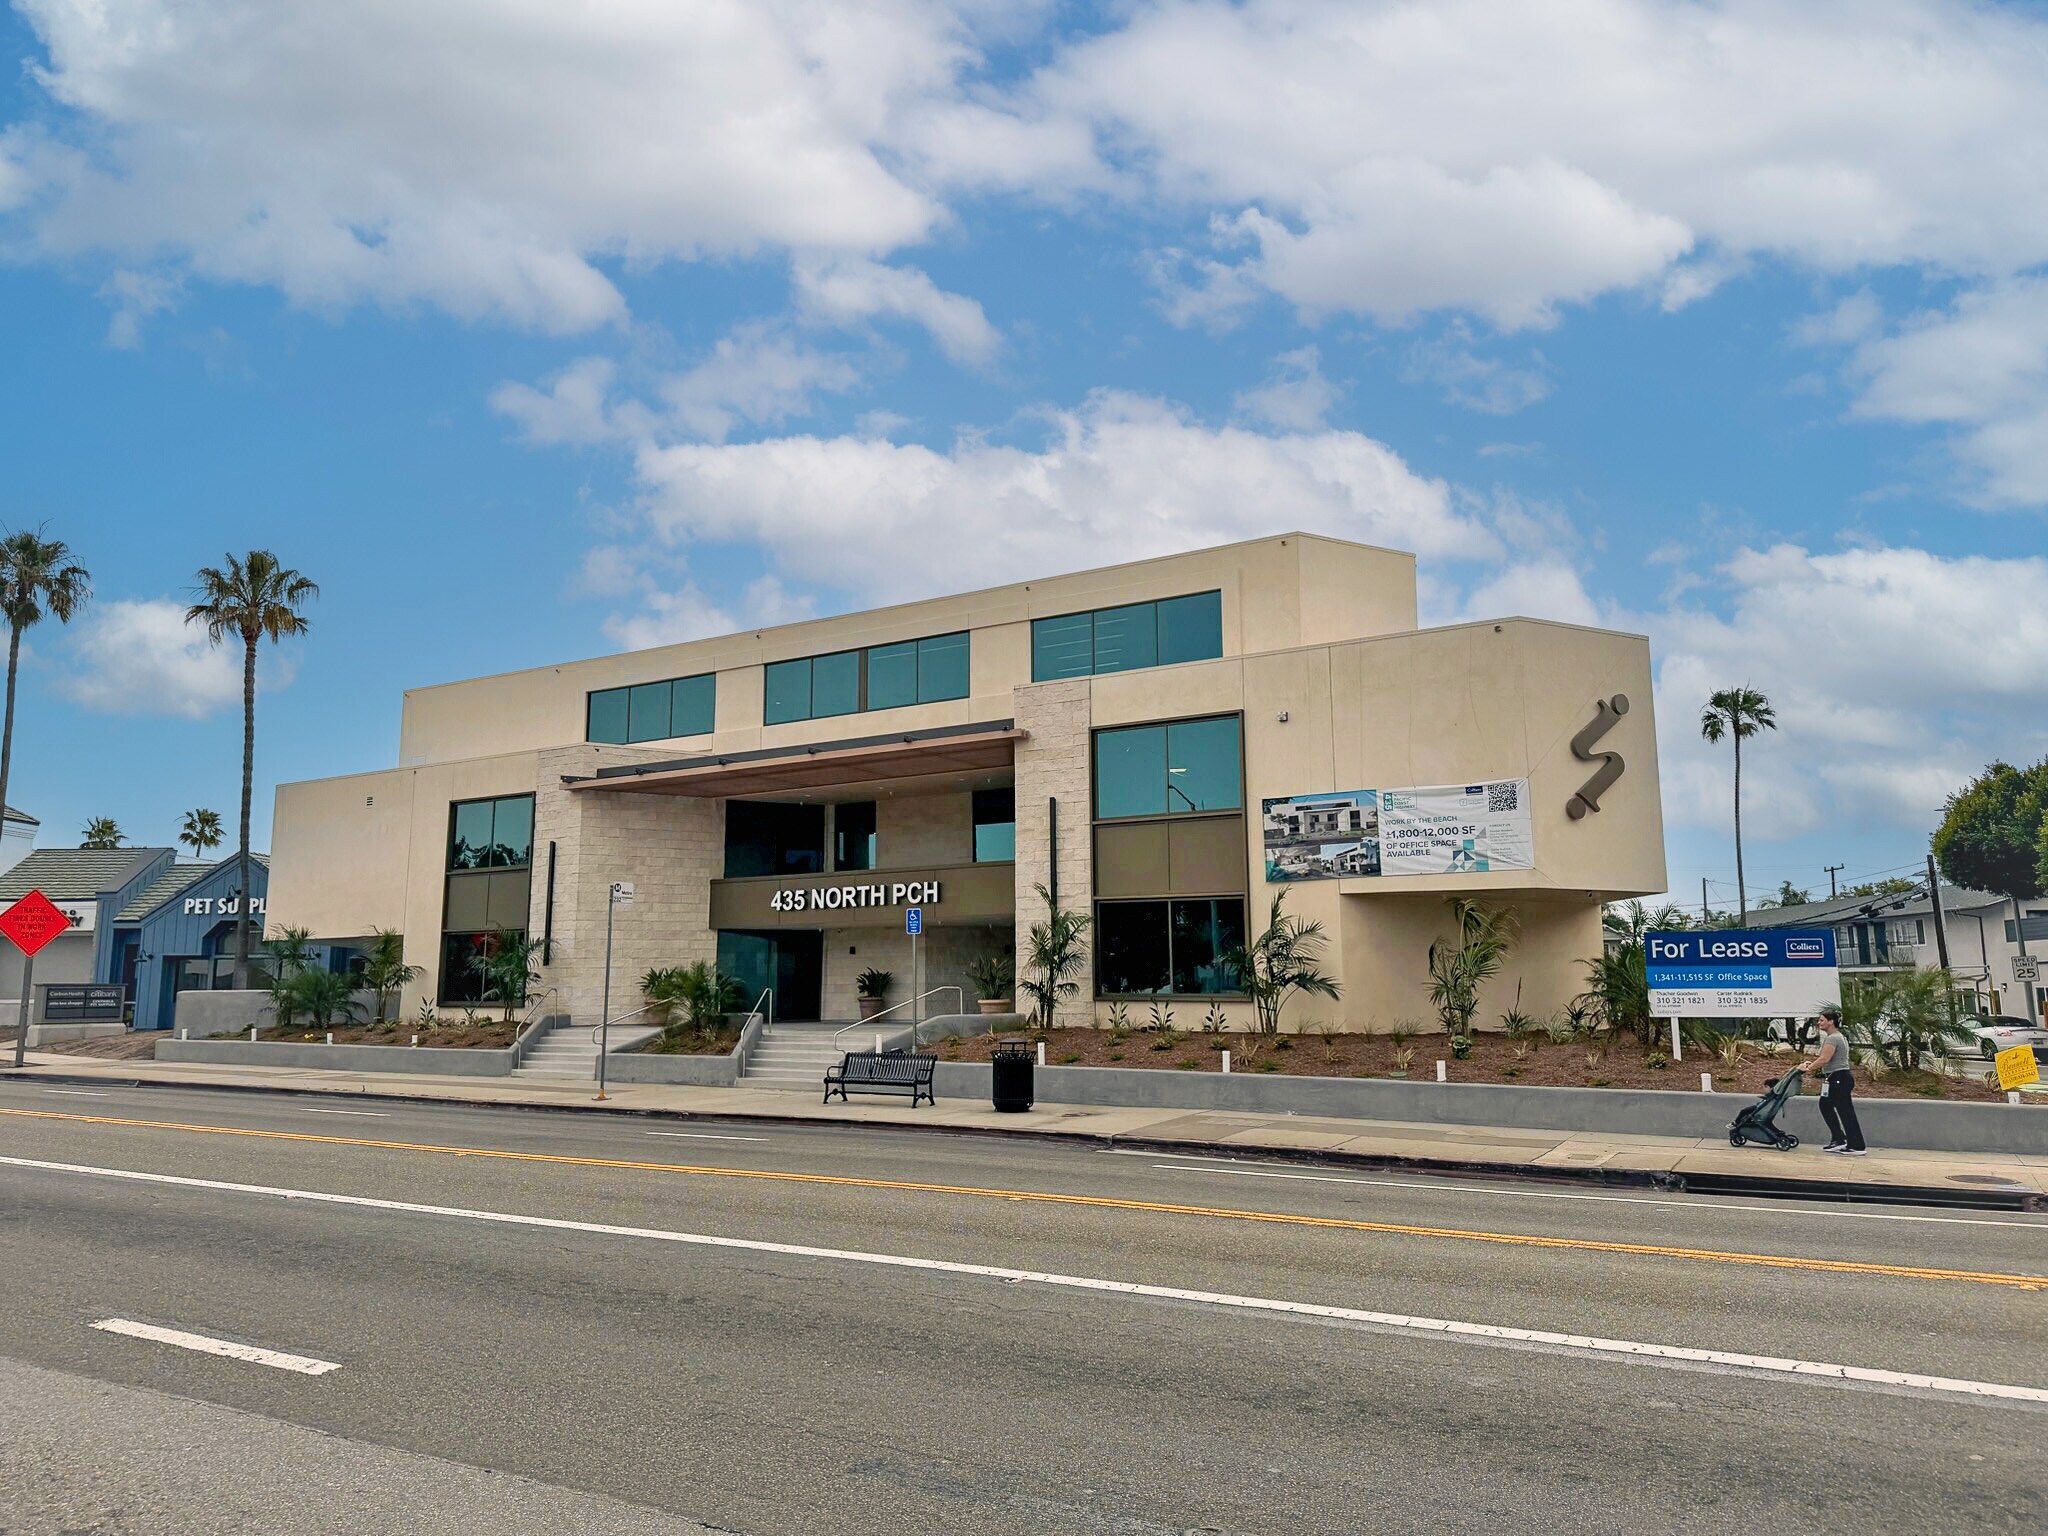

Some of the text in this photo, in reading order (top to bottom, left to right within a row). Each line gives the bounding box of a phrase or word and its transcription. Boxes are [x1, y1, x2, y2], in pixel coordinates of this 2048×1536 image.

[1384, 793, 1393, 811] 435
[1462, 825, 1476, 834] SF
[1387, 849, 1431, 858] AVAILABLE
[770, 881, 938, 911] 435 NORTH PCH
[184, 898, 266, 914] PET SUPL
[1651, 939, 1768, 958] For Lease
[1790, 942, 1820, 950] Colliers
[1654, 974, 1703, 982] 1,341-11,515
[1744, 974, 1768, 982] Space
[2017, 968, 2036, 978] 25
